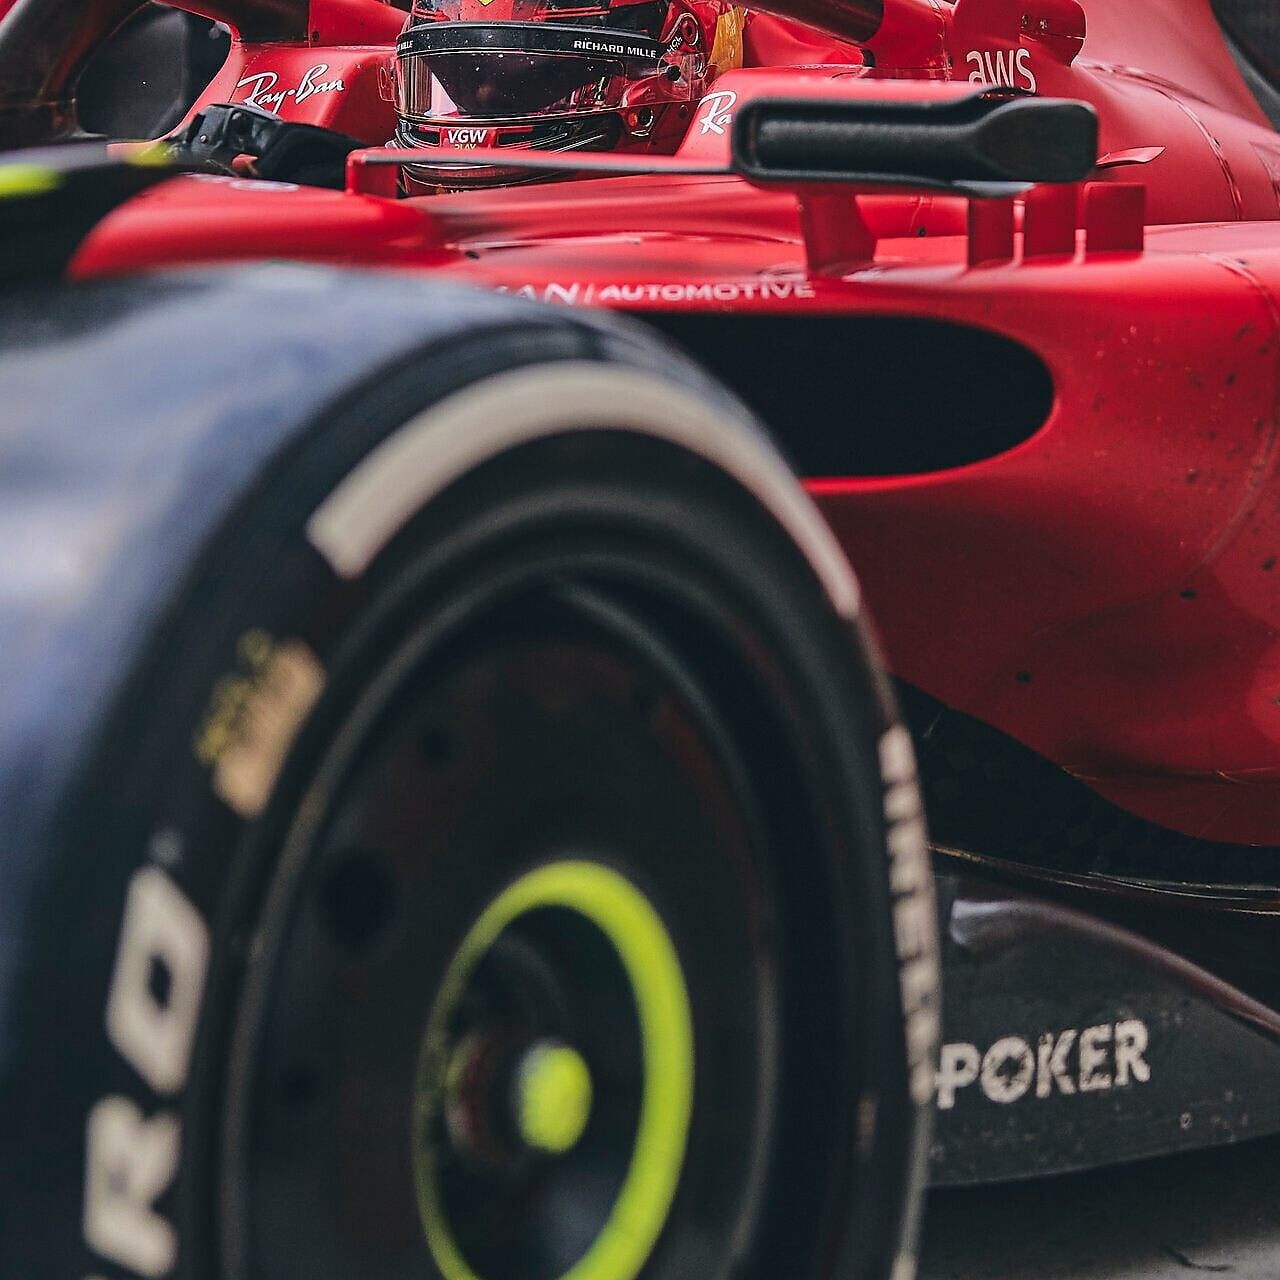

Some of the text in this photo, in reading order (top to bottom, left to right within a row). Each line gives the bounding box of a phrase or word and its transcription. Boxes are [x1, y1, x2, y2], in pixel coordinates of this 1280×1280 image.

[573, 40, 657, 59] RICHARD MILLE
[966, 48, 1037, 94] aws
[699, 91, 736, 136] Ra
[447, 129, 488, 144] VGW
[598, 281, 817, 302] AUTOMOTIVE
[83, 863, 211, 1280] RO
[936, 1019, 1151, 1110] POKER
